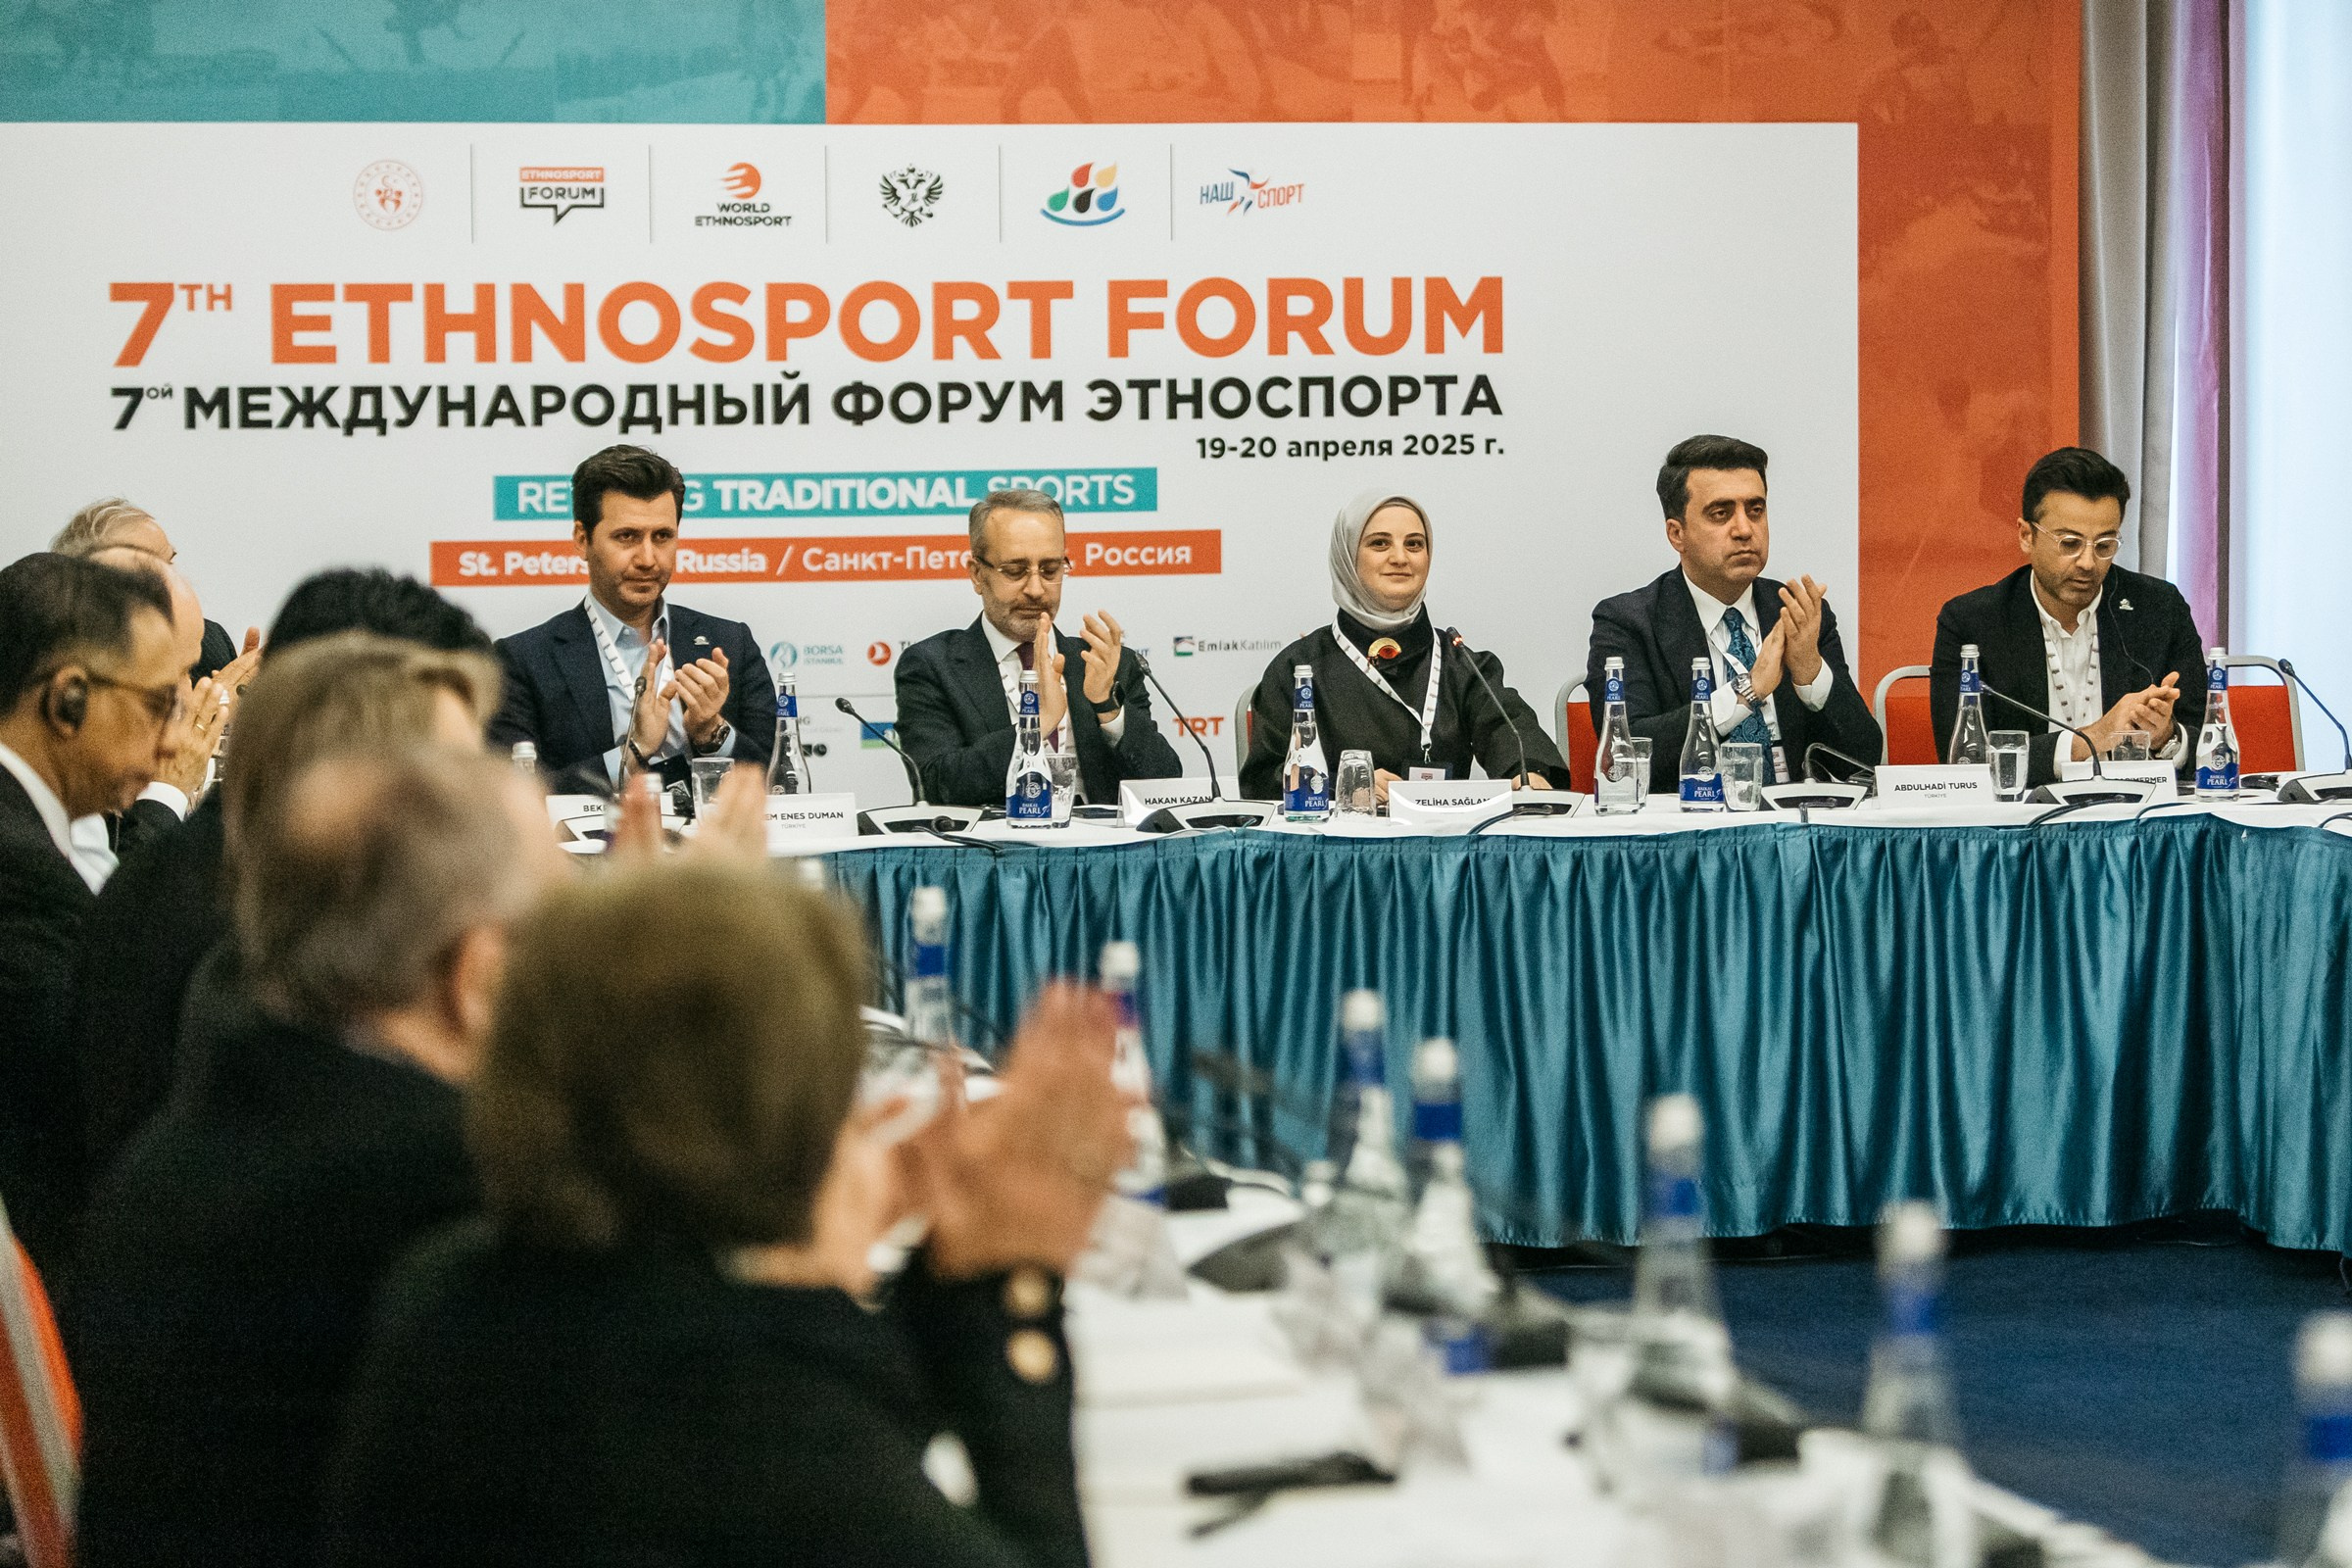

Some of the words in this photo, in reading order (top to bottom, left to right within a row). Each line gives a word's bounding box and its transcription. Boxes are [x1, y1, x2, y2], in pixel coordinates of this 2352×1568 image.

[522, 170, 600, 179] ETHNOSPORT
[529, 187, 595, 199] FORUM
[1200, 181, 1234, 204] НАШ
[1257, 183, 1304, 208] СПОРТ
[717, 203, 770, 213] WORLD
[695, 216, 791, 226] ETHNOSPORT
[270, 279, 1073, 365] ETHNOSPORT
[1107, 276, 1503, 358] FORUM
[184, 370, 810, 437] МЕЖДУНАРОДНЫЙ
[832, 379, 1064, 426] ФОРУМ
[1086, 374, 1503, 421] ЭТНОСПОРТА
[1197, 437, 1276, 459] 19-20
[1287, 440, 1393, 462] апреля
[1402, 434, 1475, 456] 2025
[1485, 438, 1504, 455] г.
[712, 476, 980, 511] TRADITIONAL
[459, 551, 498, 576] St.
[676, 548, 766, 573] Russia
[1085, 543, 1192, 565] Россия
[1173, 716, 1224, 737] TRT
[1894, 781, 1946, 792] ABDULHADİ
[1949, 781, 1978, 790] TURUS
[1415, 798, 1449, 807] ZELİHA
